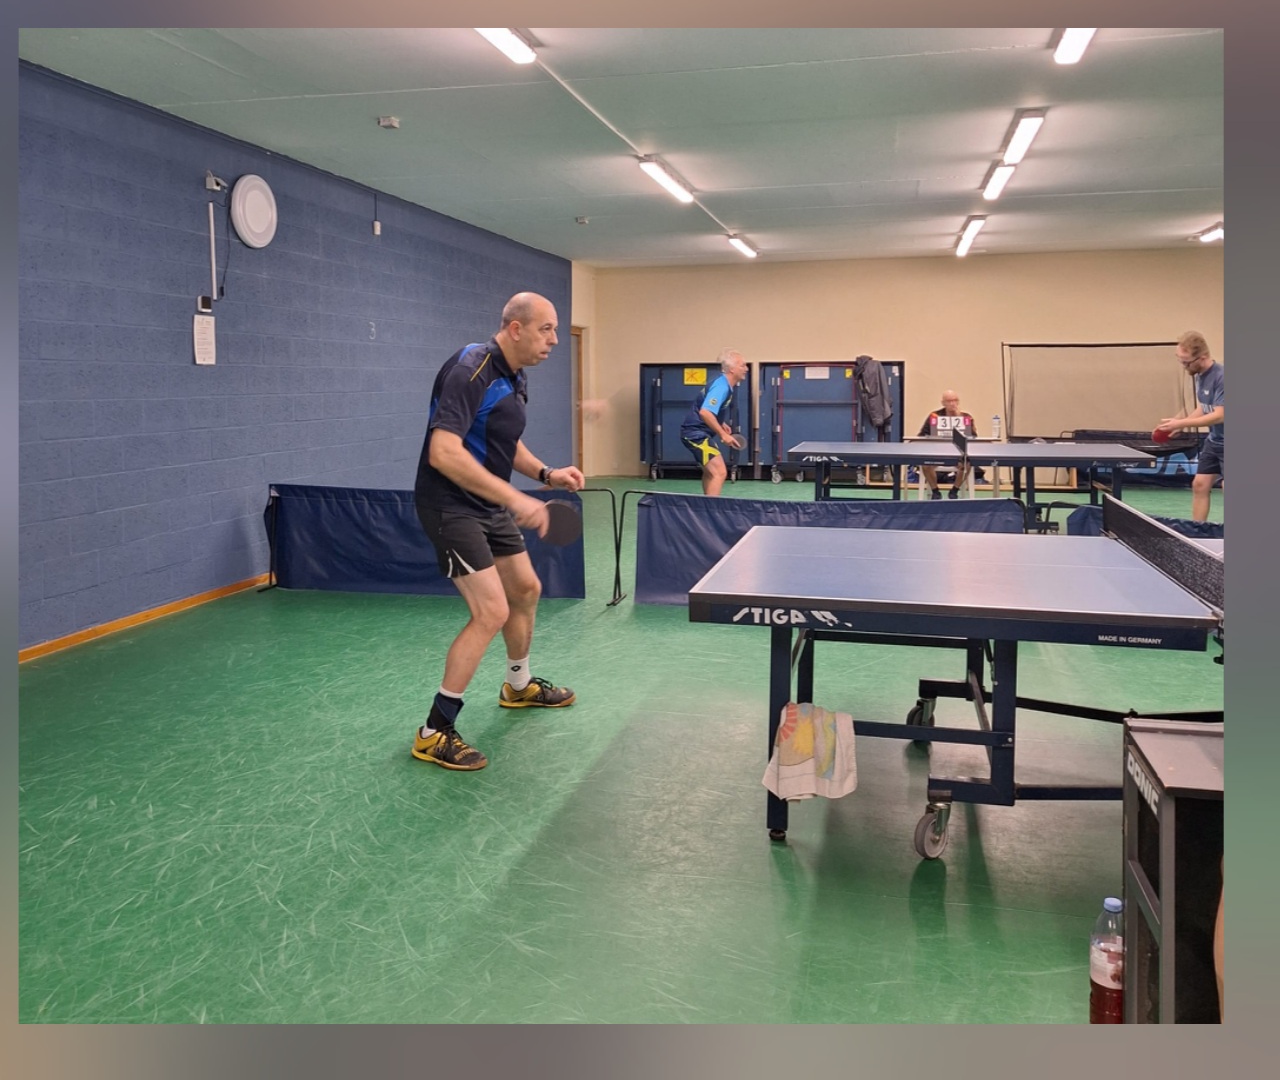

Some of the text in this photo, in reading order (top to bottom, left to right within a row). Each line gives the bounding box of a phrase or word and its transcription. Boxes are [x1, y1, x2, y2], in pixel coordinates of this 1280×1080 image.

[941, 418, 948, 428] 3
[732, 607, 807, 625] STIGA
[1098, 634, 1118, 642] MADE
[1127, 636, 1162, 645] GERMANY
[1127, 751, 1159, 816] DONIC
